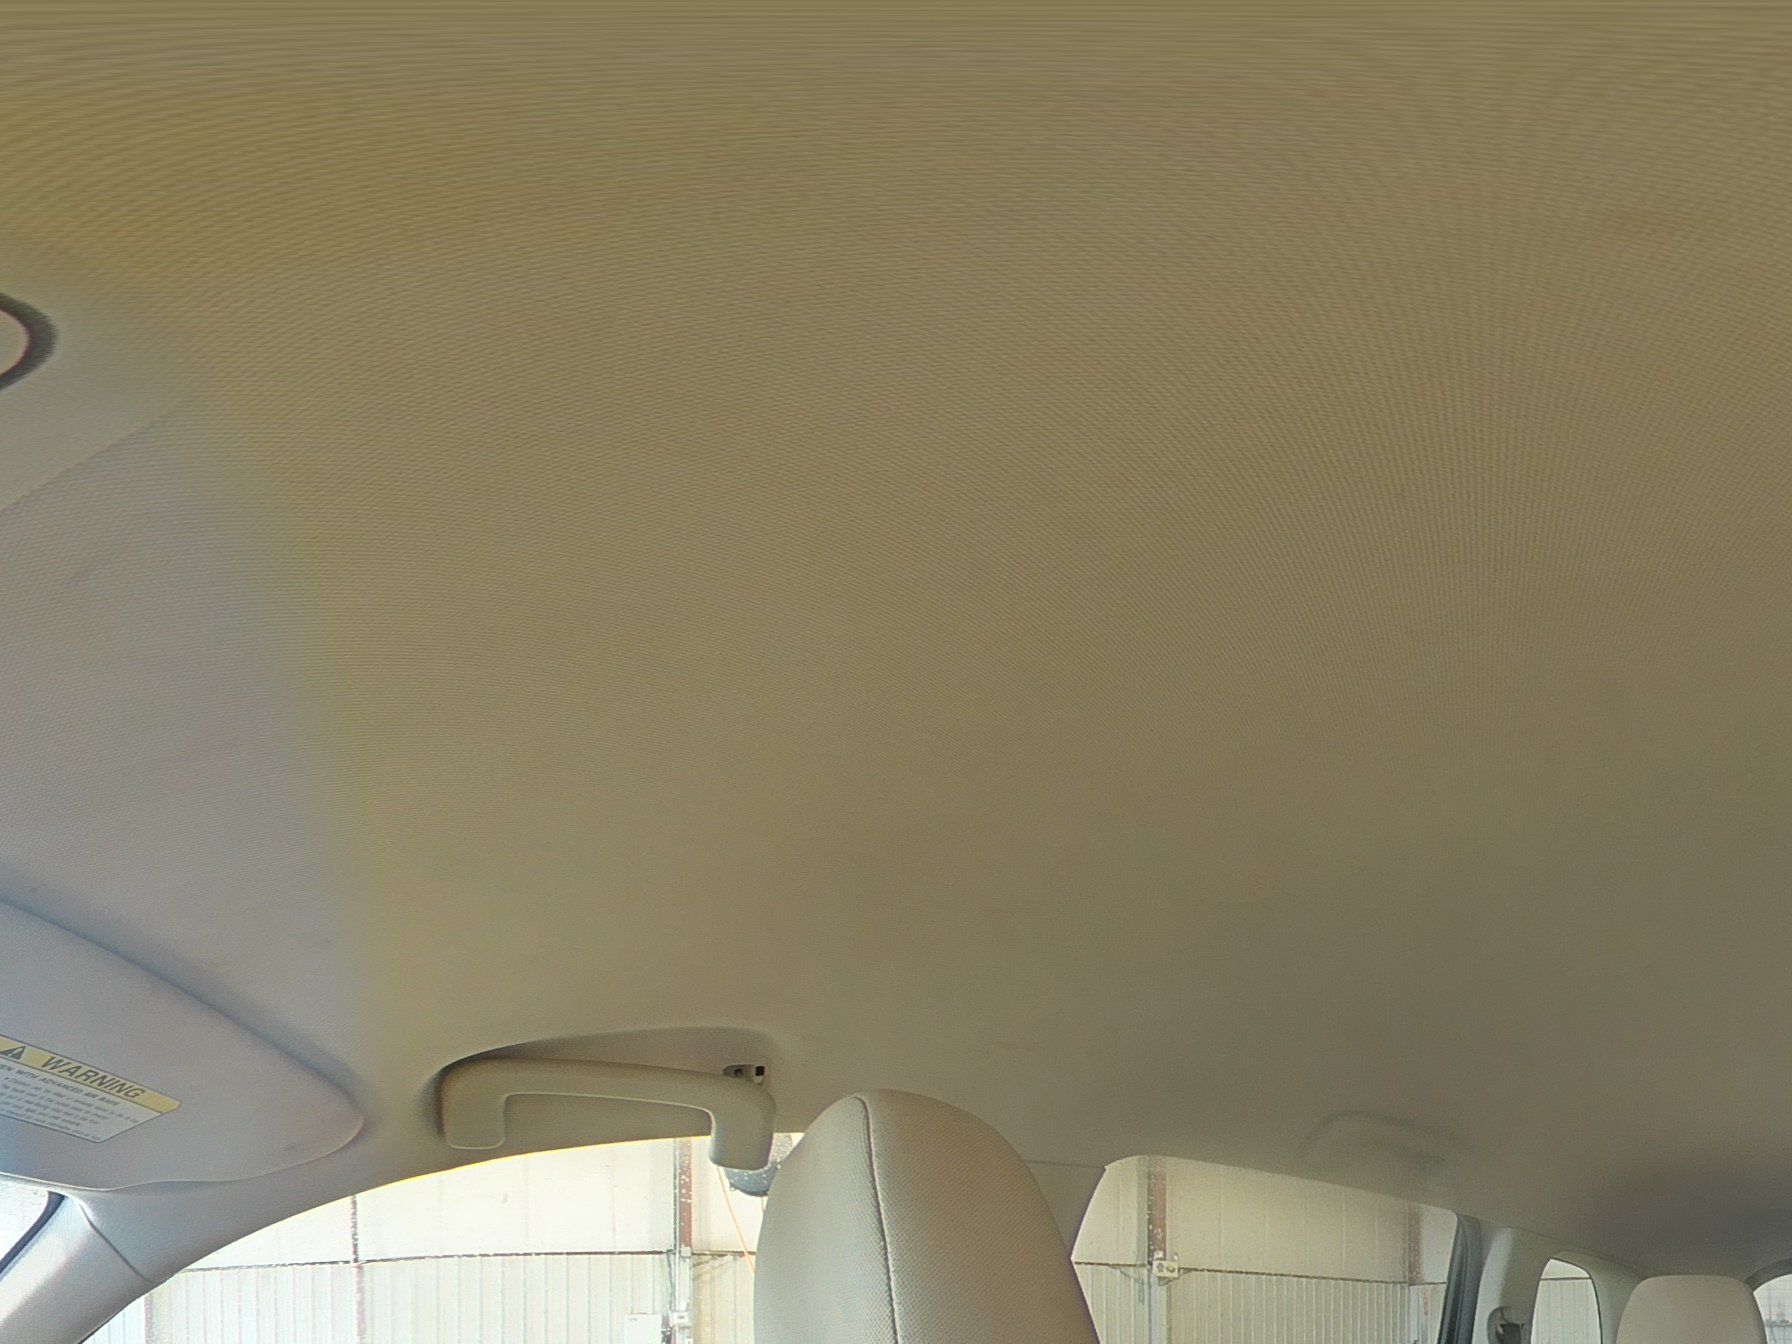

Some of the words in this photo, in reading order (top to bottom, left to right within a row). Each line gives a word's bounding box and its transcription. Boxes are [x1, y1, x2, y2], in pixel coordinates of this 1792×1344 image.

[15, 1069, 40, 1079] WITH
[39, 1077, 83, 1094] ADVANCED
[83, 1091, 98, 1099] AIR
[41, 1056, 146, 1099] WARNING
